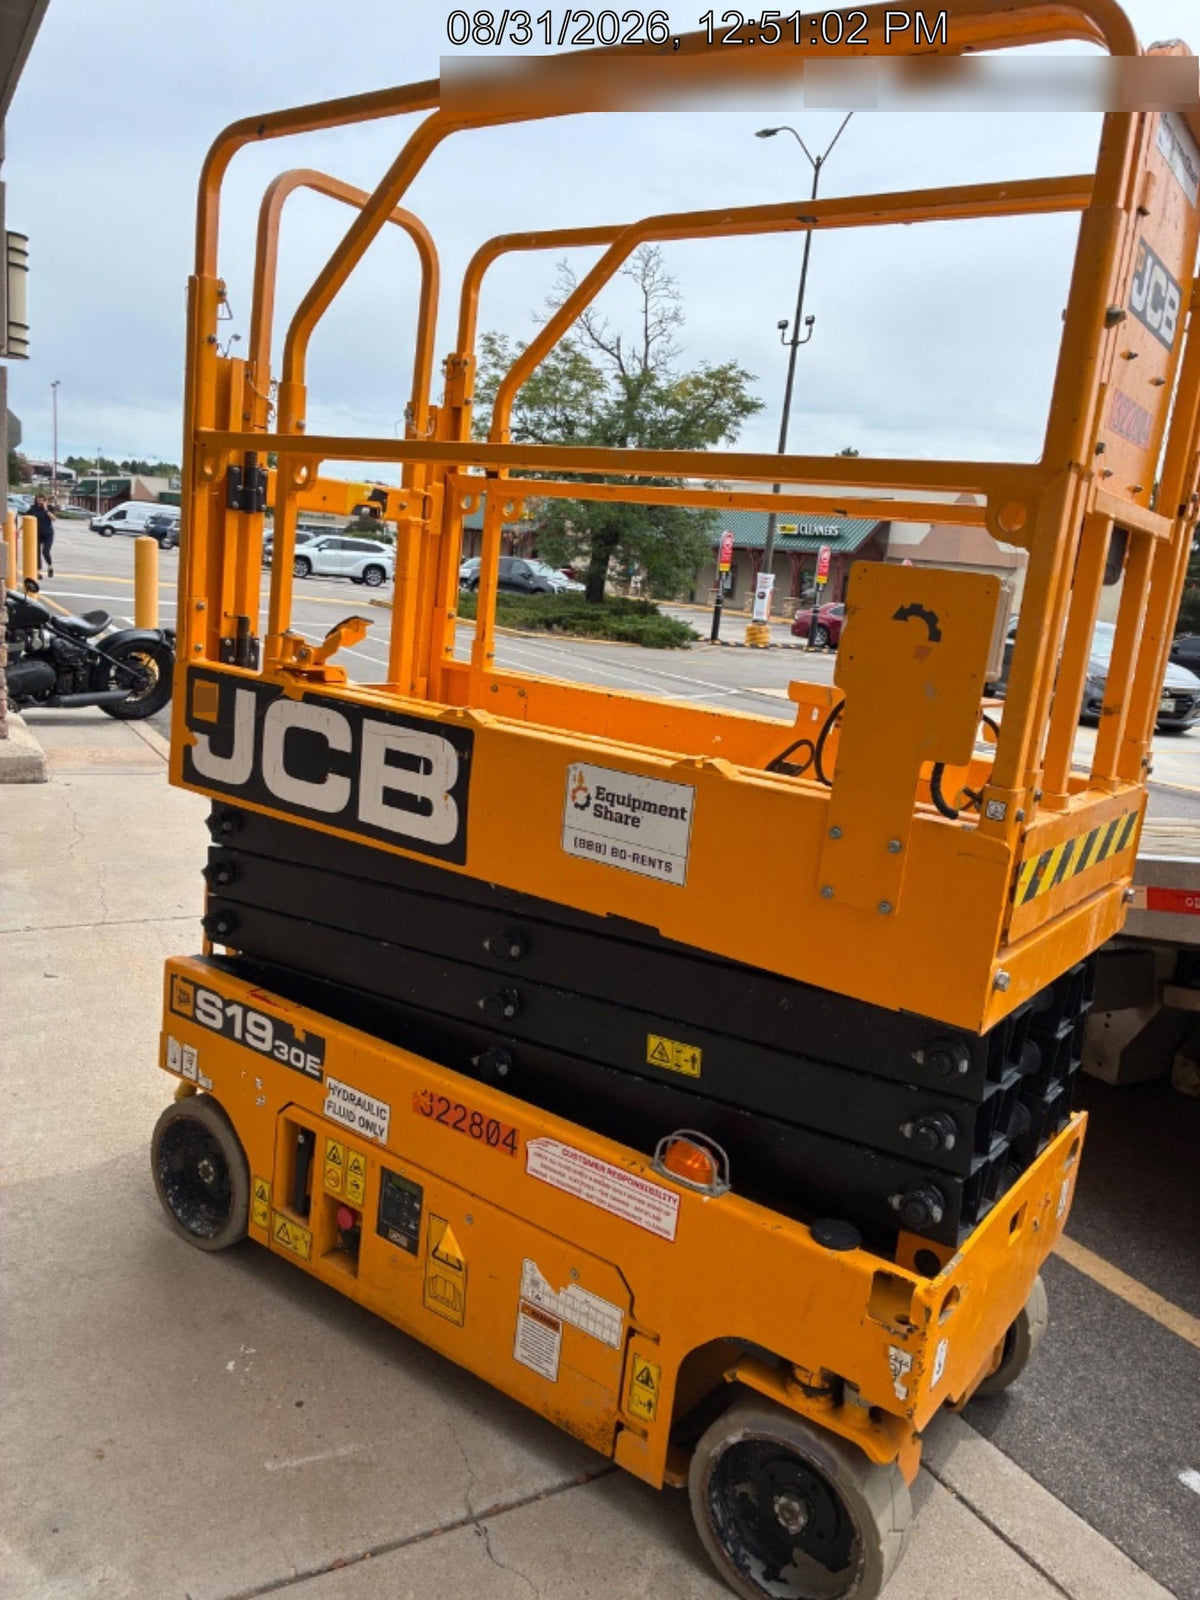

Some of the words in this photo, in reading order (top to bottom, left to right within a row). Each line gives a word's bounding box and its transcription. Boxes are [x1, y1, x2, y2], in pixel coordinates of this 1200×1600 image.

[1131, 255, 1180, 345] JCB
[800, 524, 839, 536] CLEANERS
[191, 687, 460, 845] JCB
[593, 803, 641, 828] Share
[595, 785, 688, 821] Equipment
[573, 836, 607, 855] (888)
[611, 847, 673, 873] 80-RENTS
[326, 1101, 356, 1124] FLUID
[358, 1115, 386, 1139] ONLY
[328, 1082, 387, 1121] HYDRAULIC
[561, 1148, 606, 1174] CUSTOMER
[607, 1168, 678, 1205] RESPONSIBILITY
